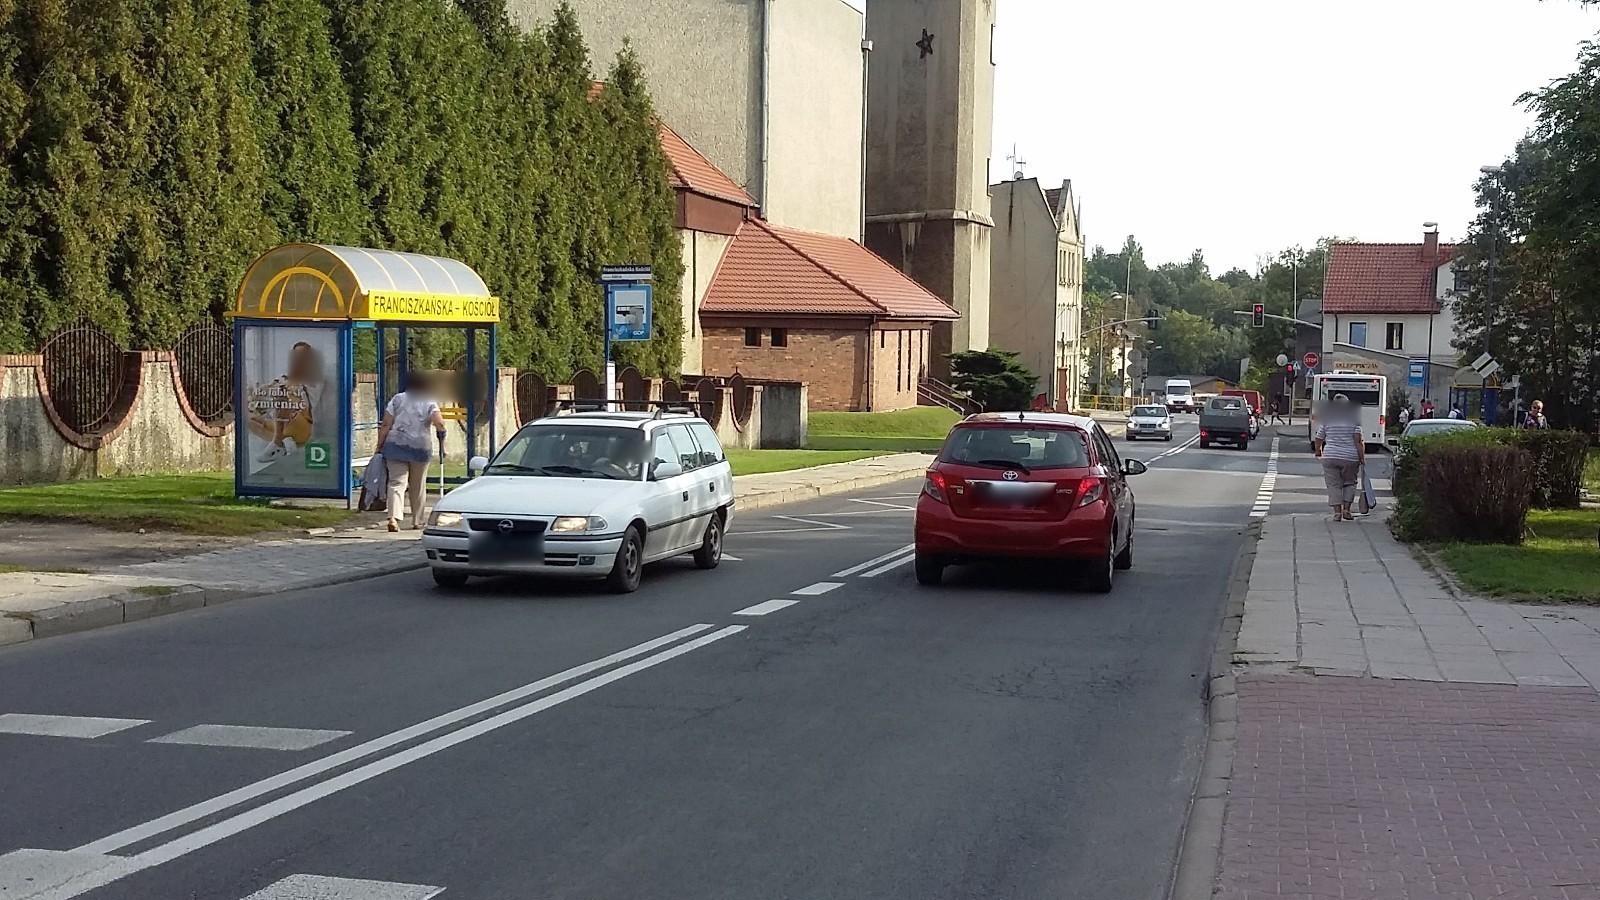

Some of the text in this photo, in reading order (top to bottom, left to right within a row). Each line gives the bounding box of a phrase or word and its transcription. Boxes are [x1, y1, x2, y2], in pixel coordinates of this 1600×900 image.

[373, 295, 454, 316] FRANCISZKAŃSKA
[463, 297, 497, 317] KOŚCIÓŁ
[254, 399, 306, 409] zmieniać
[310, 446, 326, 462] D
